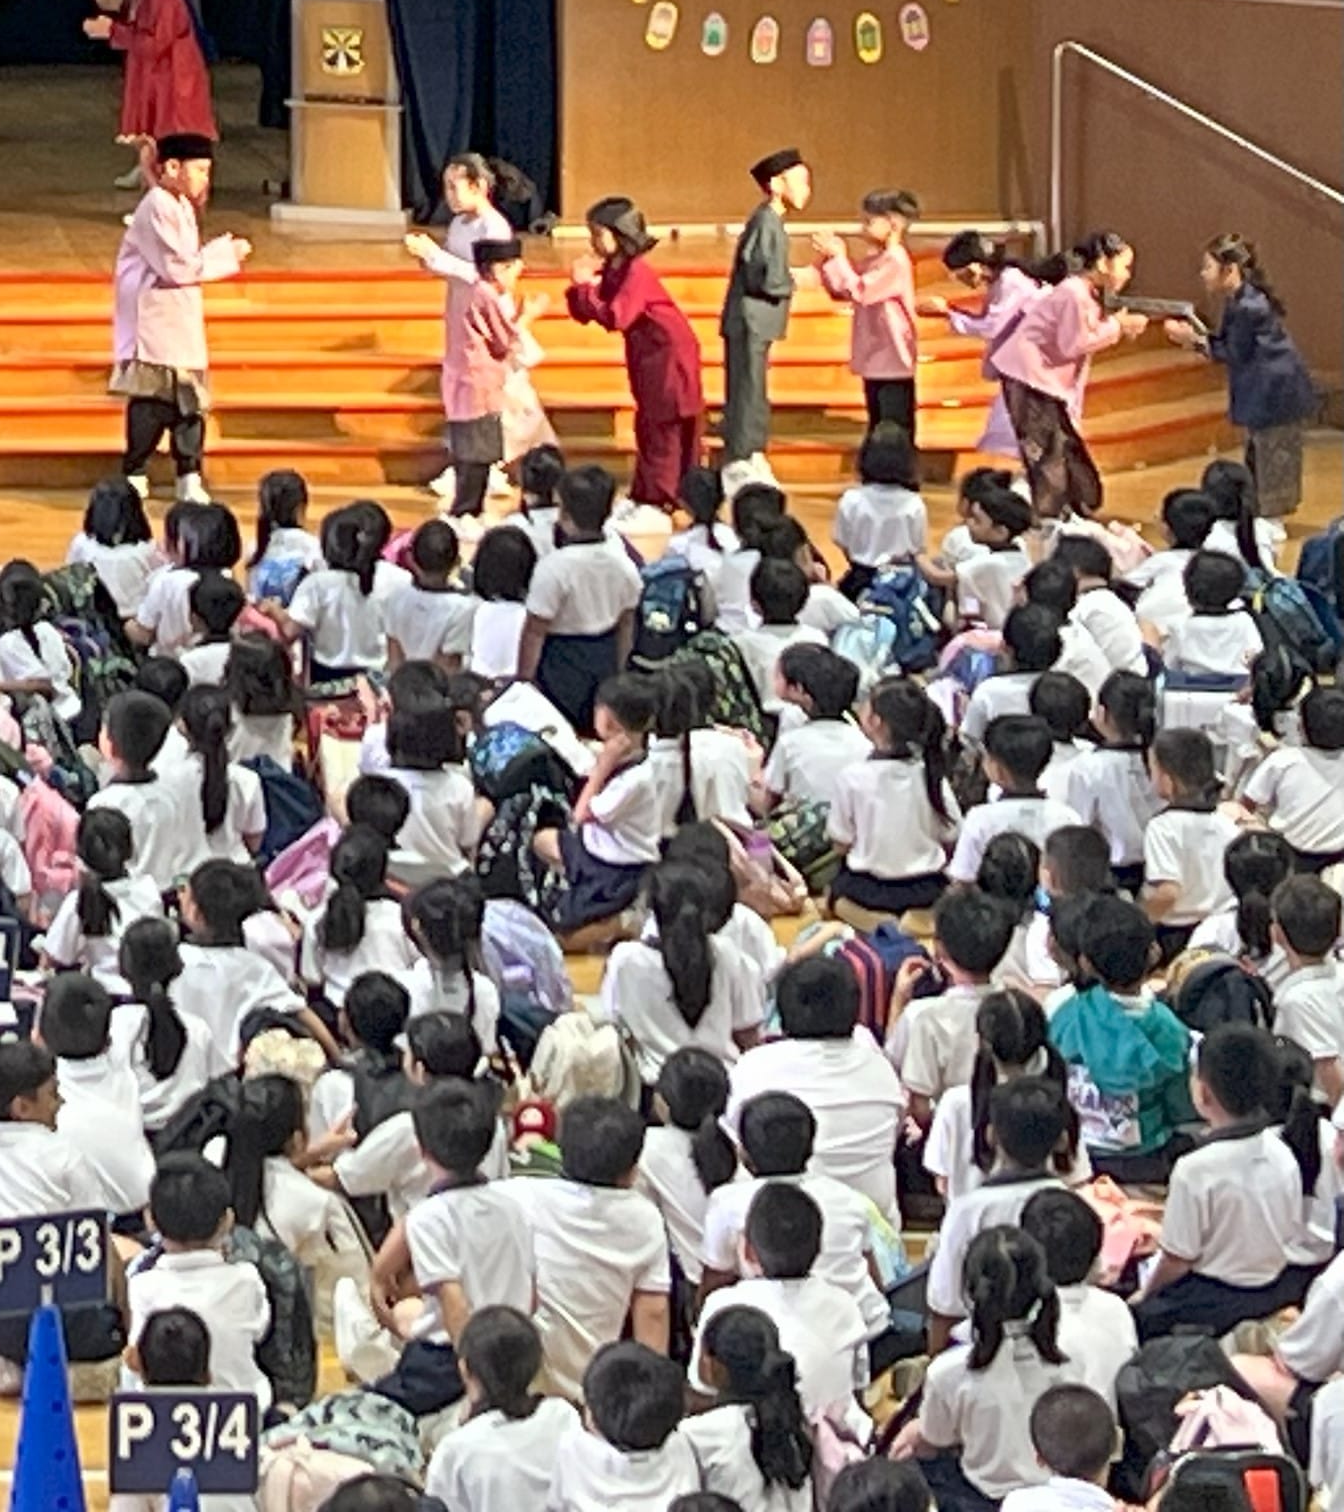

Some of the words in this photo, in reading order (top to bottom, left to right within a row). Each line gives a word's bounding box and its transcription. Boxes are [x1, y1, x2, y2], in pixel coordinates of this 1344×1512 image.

[35, 1219, 101, 1276] 3/3
[116, 1402, 154, 1460] P
[170, 1402, 250, 1461] 3/4
